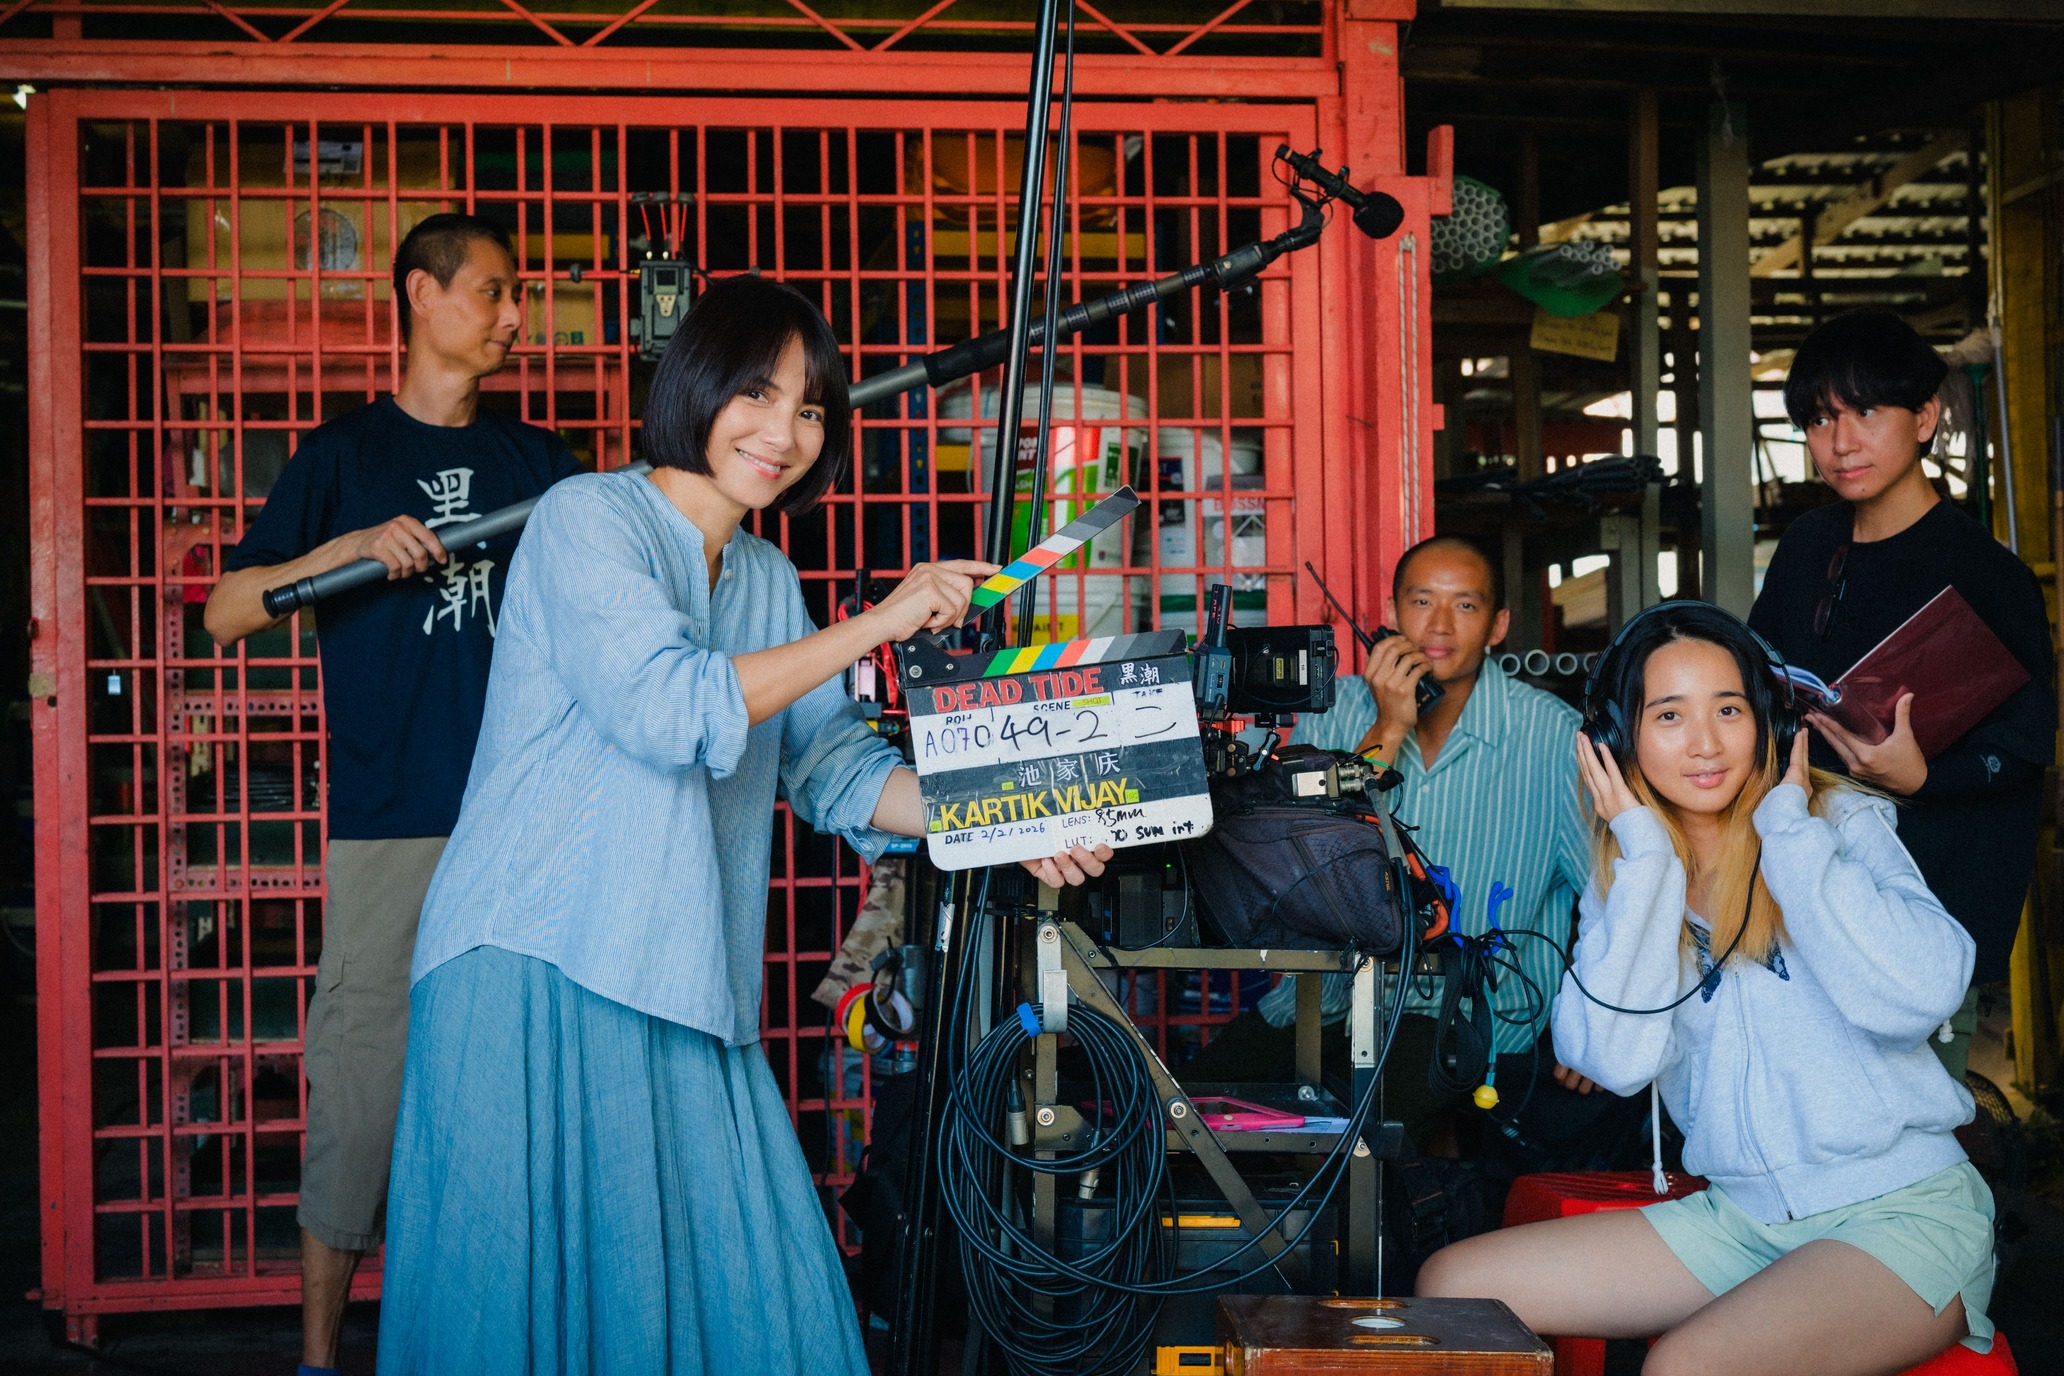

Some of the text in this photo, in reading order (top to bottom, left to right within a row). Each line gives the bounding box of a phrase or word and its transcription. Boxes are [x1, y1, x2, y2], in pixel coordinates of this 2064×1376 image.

[933, 668, 1104, 713] DEAD TIDE
[1033, 701, 1071, 712] SCENE
[1082, 697, 1102, 706] SHOT
[940, 777, 1128, 831] KARTIK VIJAY
[1062, 815, 1091, 828] LENS:
[945, 832, 974, 845] DATE
